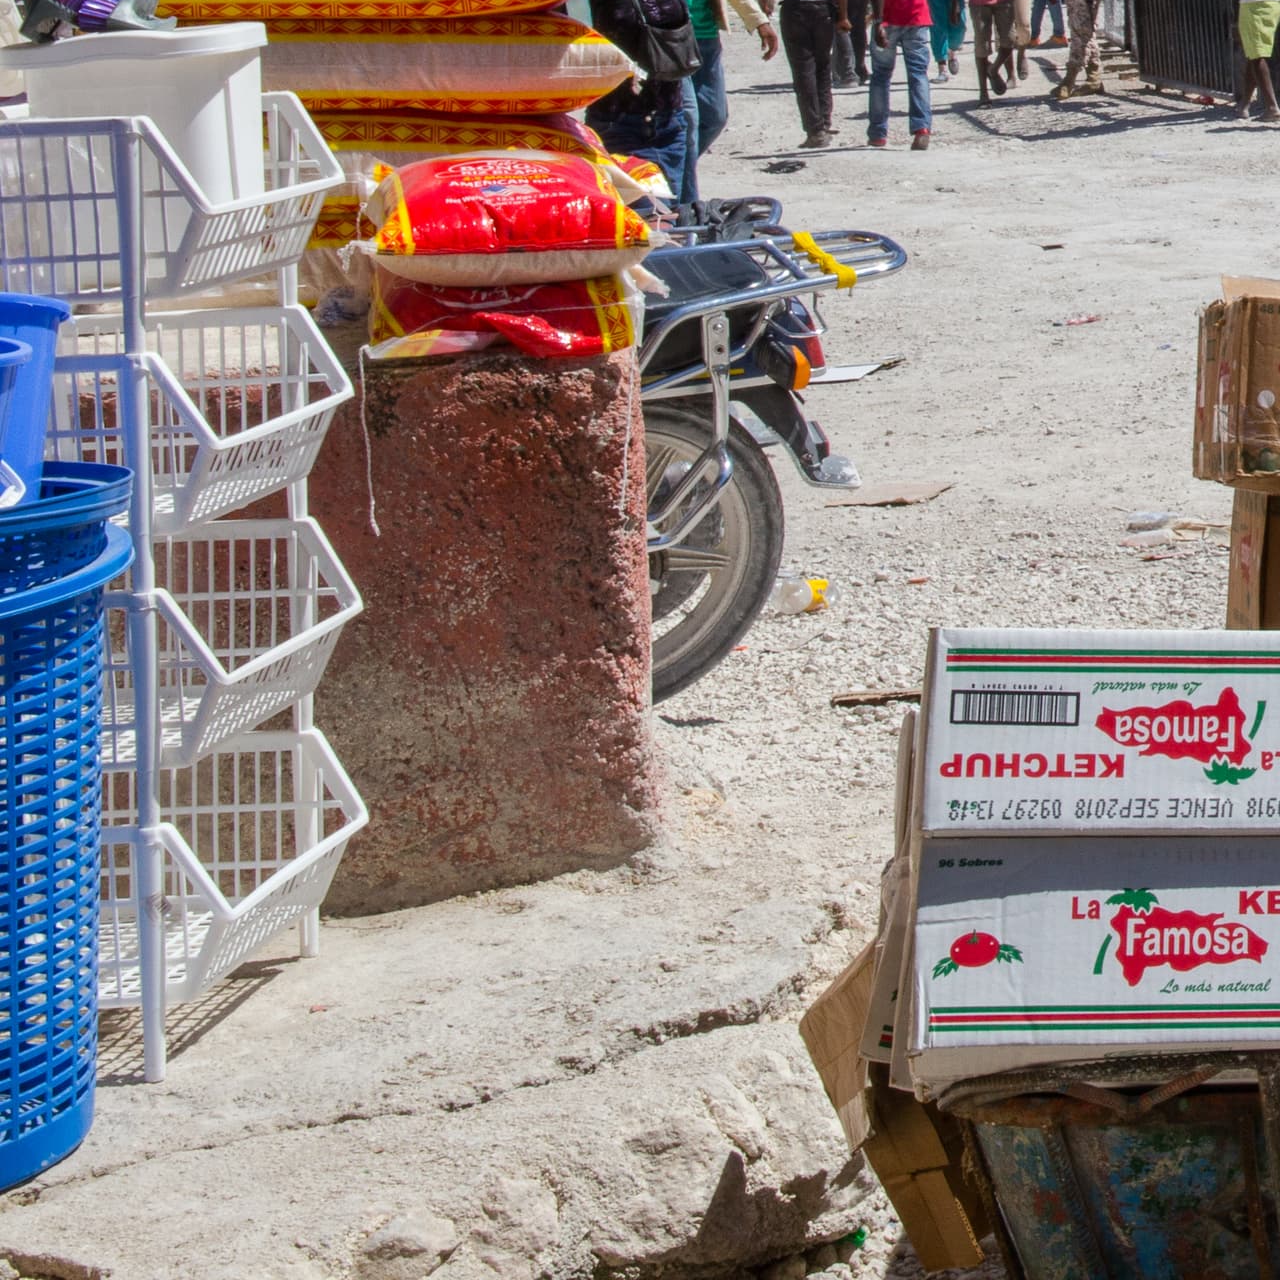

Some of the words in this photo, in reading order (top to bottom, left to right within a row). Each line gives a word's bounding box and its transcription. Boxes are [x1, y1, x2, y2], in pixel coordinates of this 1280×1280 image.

[449, 179, 529, 188] AMERICAN
[1259, 304, 1275, 316] 48
[1092, 680, 1146, 695] natural
[1151, 681, 1178, 691] más
[1183, 681, 1202, 696] Lo
[1115, 715, 1235, 752] Famosa
[940, 753, 1124, 778] KETCHUP
[1002, 799, 1061, 820] 09297
[1074, 798, 1160, 820] SEP2018
[1166, 798, 1233, 818] VENCE
[938, 858, 954, 868] 96
[958, 857, 1003, 867] Sobres
[1072, 896, 1100, 920] La
[1126, 918, 1249, 956] Famosa
[1160, 979, 1180, 994] Lo
[1185, 979, 1212, 993] más
[1217, 978, 1272, 993] natural
